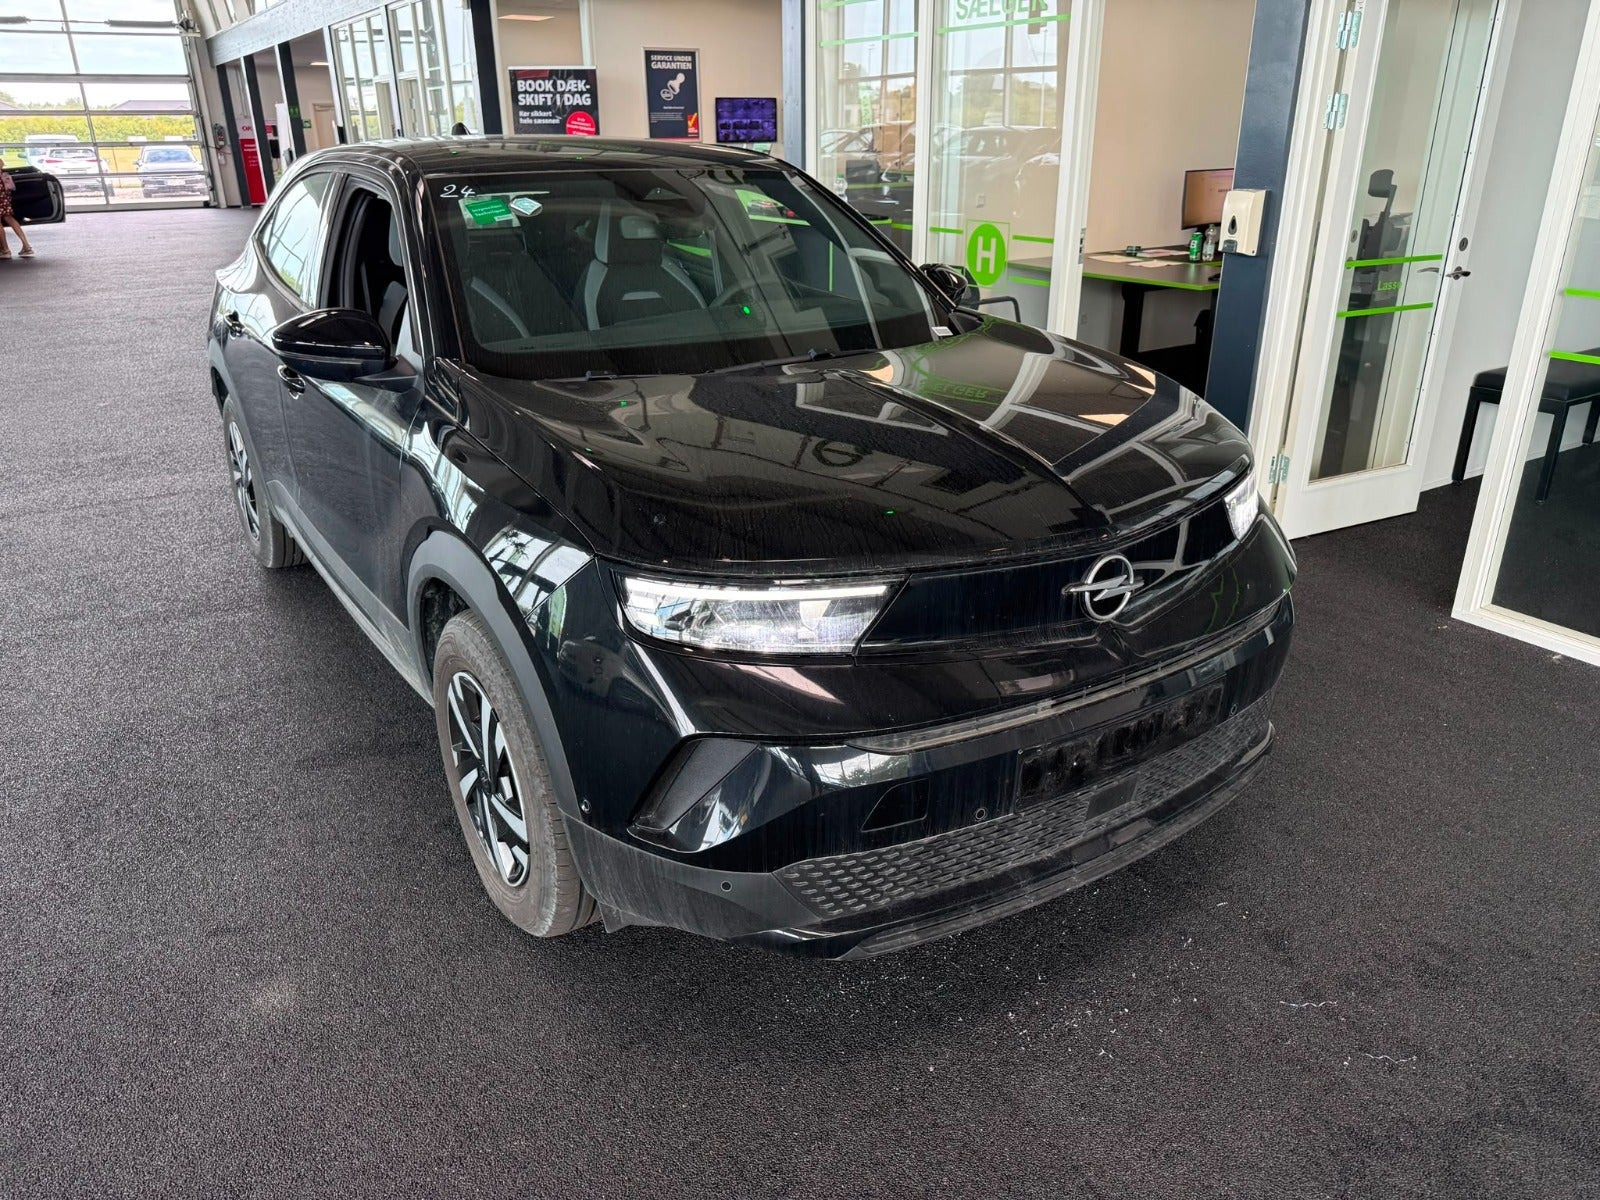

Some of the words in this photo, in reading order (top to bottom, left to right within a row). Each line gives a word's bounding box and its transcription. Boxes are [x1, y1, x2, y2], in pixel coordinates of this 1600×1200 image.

[651, 61, 692, 70] GARANTIEN
[516, 79, 555, 92] BOOK
[556, 79, 591, 92] DÆK-
[517, 93, 553, 106] SKIFT
[555, 93, 561, 106] I
[563, 93, 592, 106] DAG
[438, 184, 476, 198] 24
[975, 236, 997, 275] H
